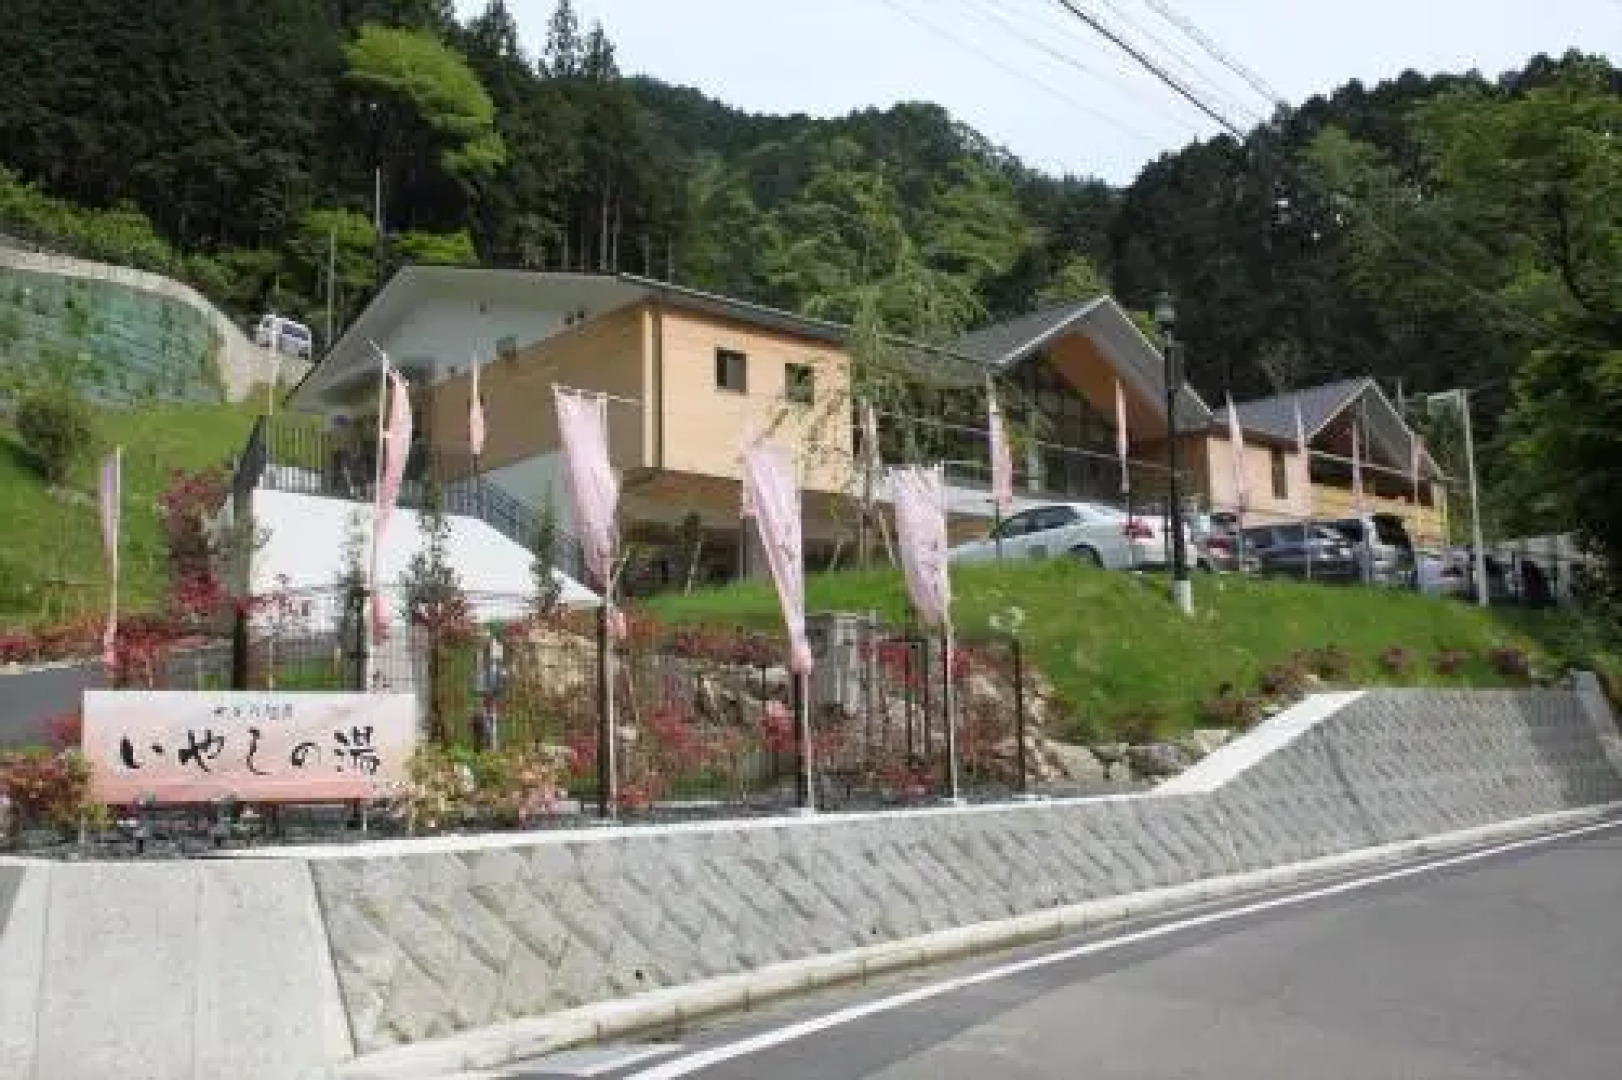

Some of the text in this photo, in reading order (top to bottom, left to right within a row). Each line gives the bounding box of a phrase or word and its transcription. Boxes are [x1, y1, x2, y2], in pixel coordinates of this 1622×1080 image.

[119, 725, 381, 776] いやしの湯
